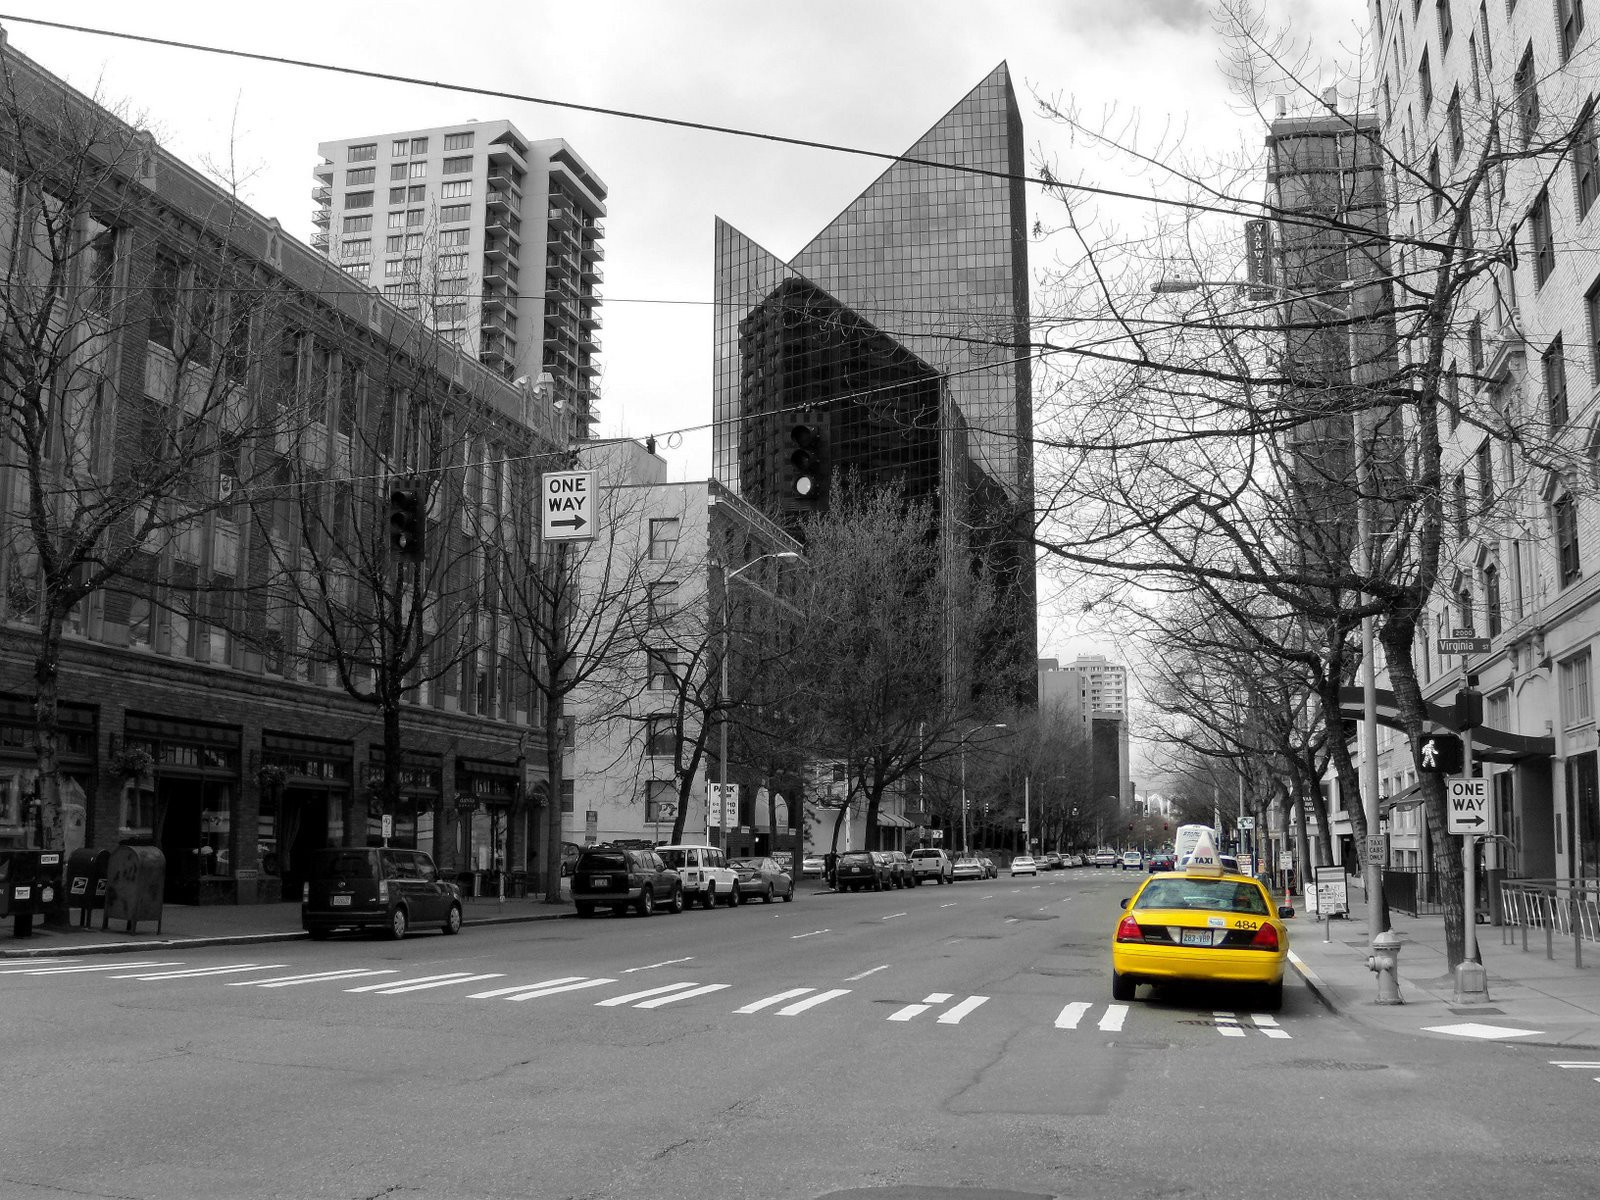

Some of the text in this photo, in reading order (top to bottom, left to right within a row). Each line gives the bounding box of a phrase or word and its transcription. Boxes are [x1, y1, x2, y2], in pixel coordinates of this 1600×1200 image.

[1252, 223, 1265, 285] WARWICK
[549, 478, 586, 493] ONE
[548, 496, 587, 512] WAY
[1439, 640, 1474, 653] Virginia
[1452, 783, 1485, 796] ONE
[1452, 798, 1485, 811] WAY
[1194, 856, 1213, 864] TAXI
[1234, 919, 1257, 930] 484
